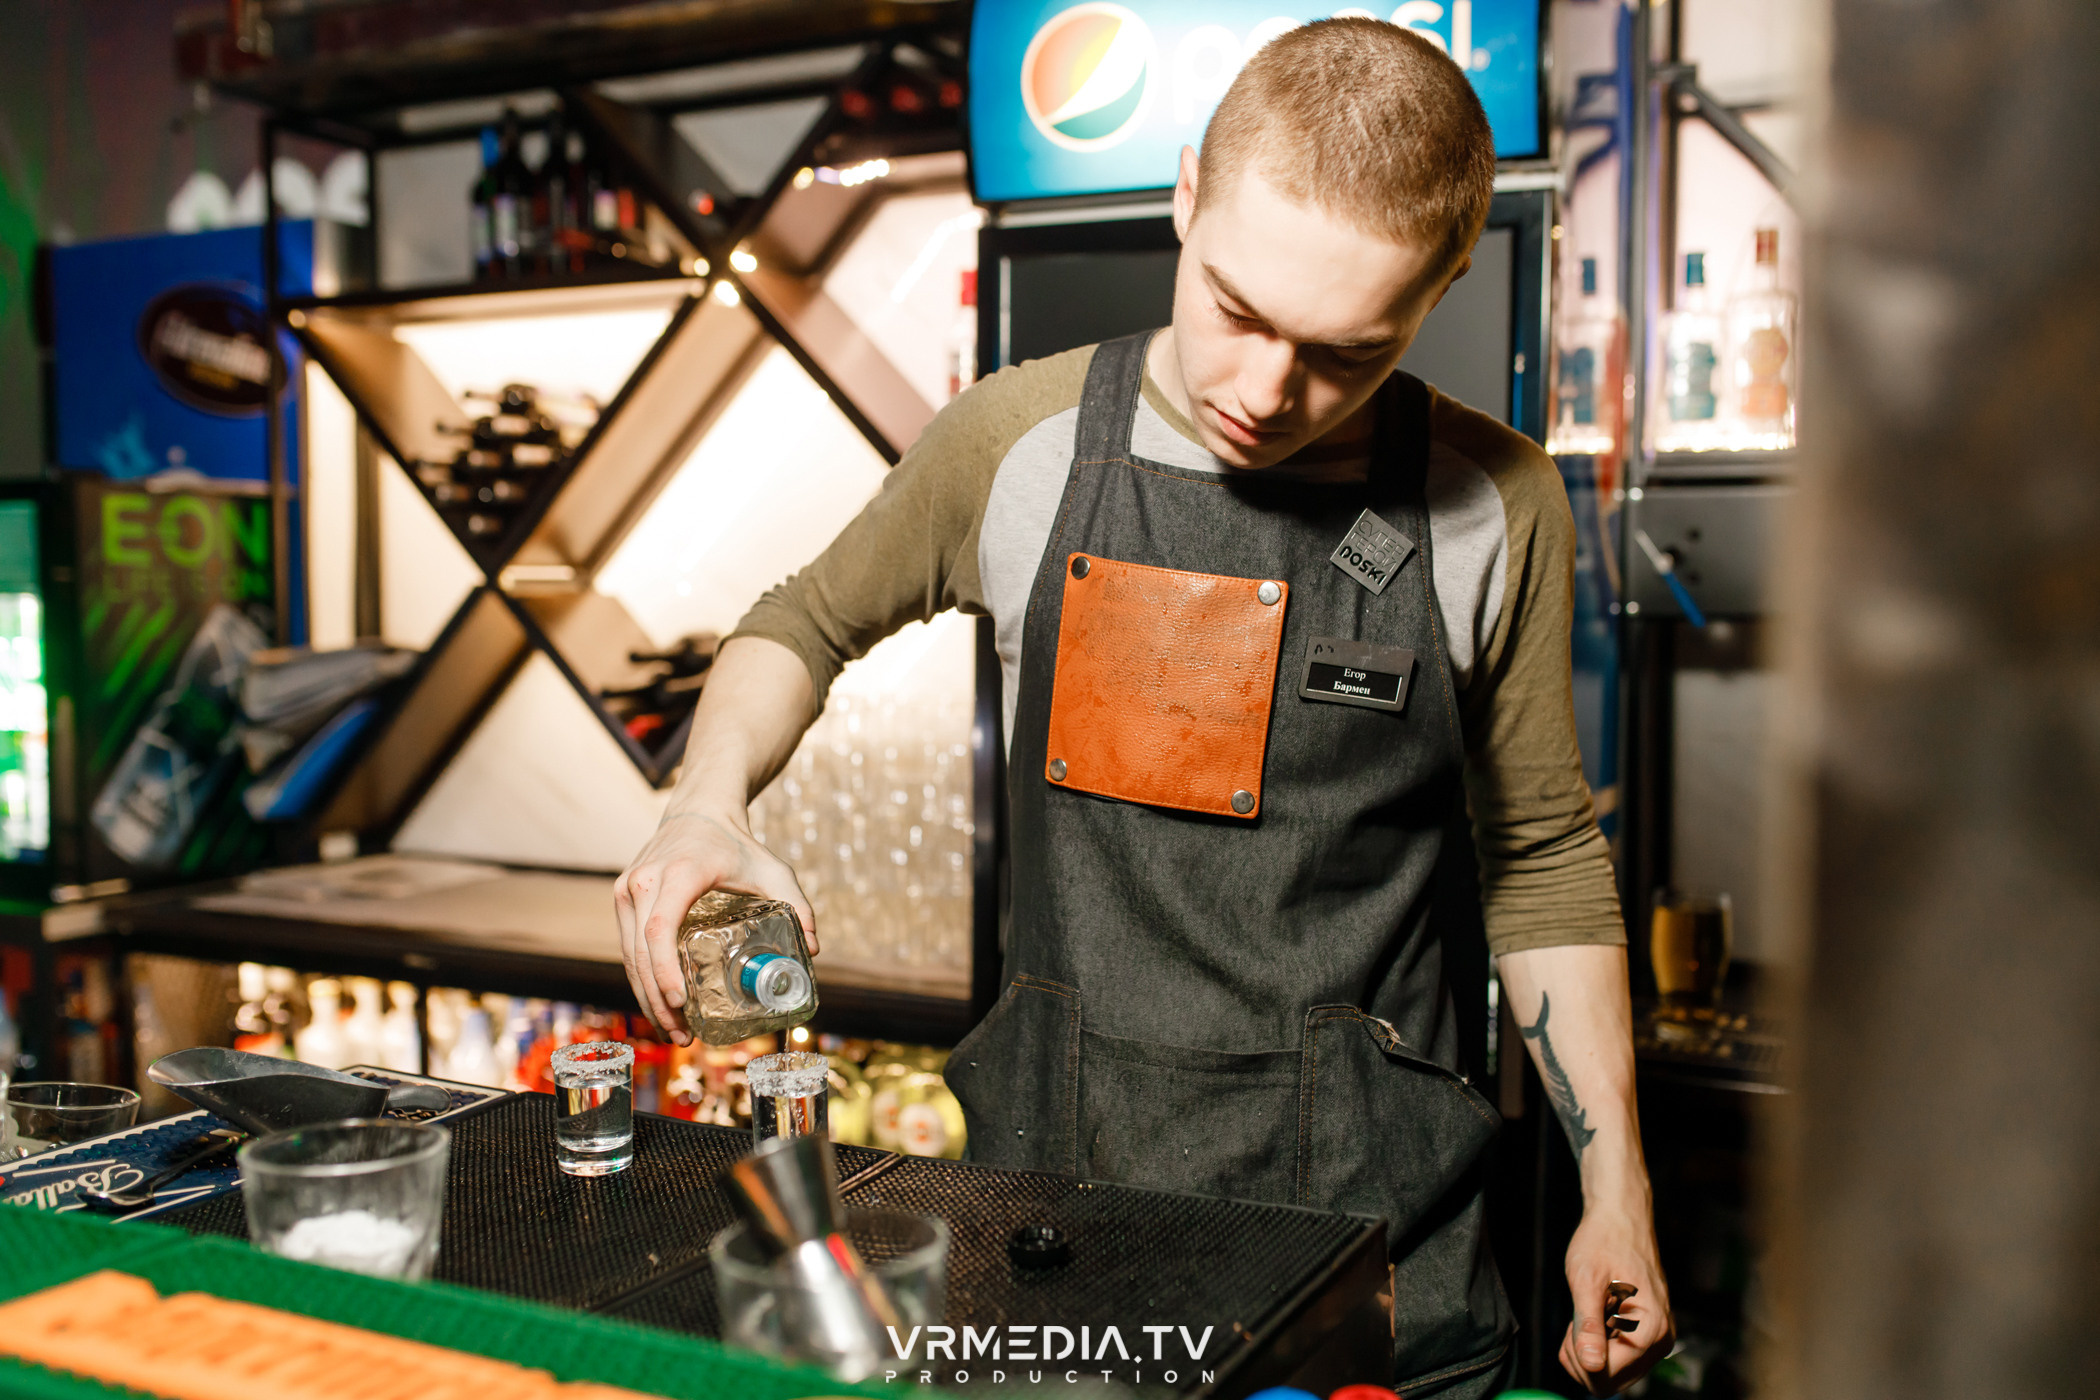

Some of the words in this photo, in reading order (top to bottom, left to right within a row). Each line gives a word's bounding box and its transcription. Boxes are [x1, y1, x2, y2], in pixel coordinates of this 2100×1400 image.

[1358, 520, 1405, 557] СУПЕР
[1339, 545, 1388, 587] DOSKI
[1343, 667, 1367, 682] Егор
[1332, 680, 1371, 696] Бармен
